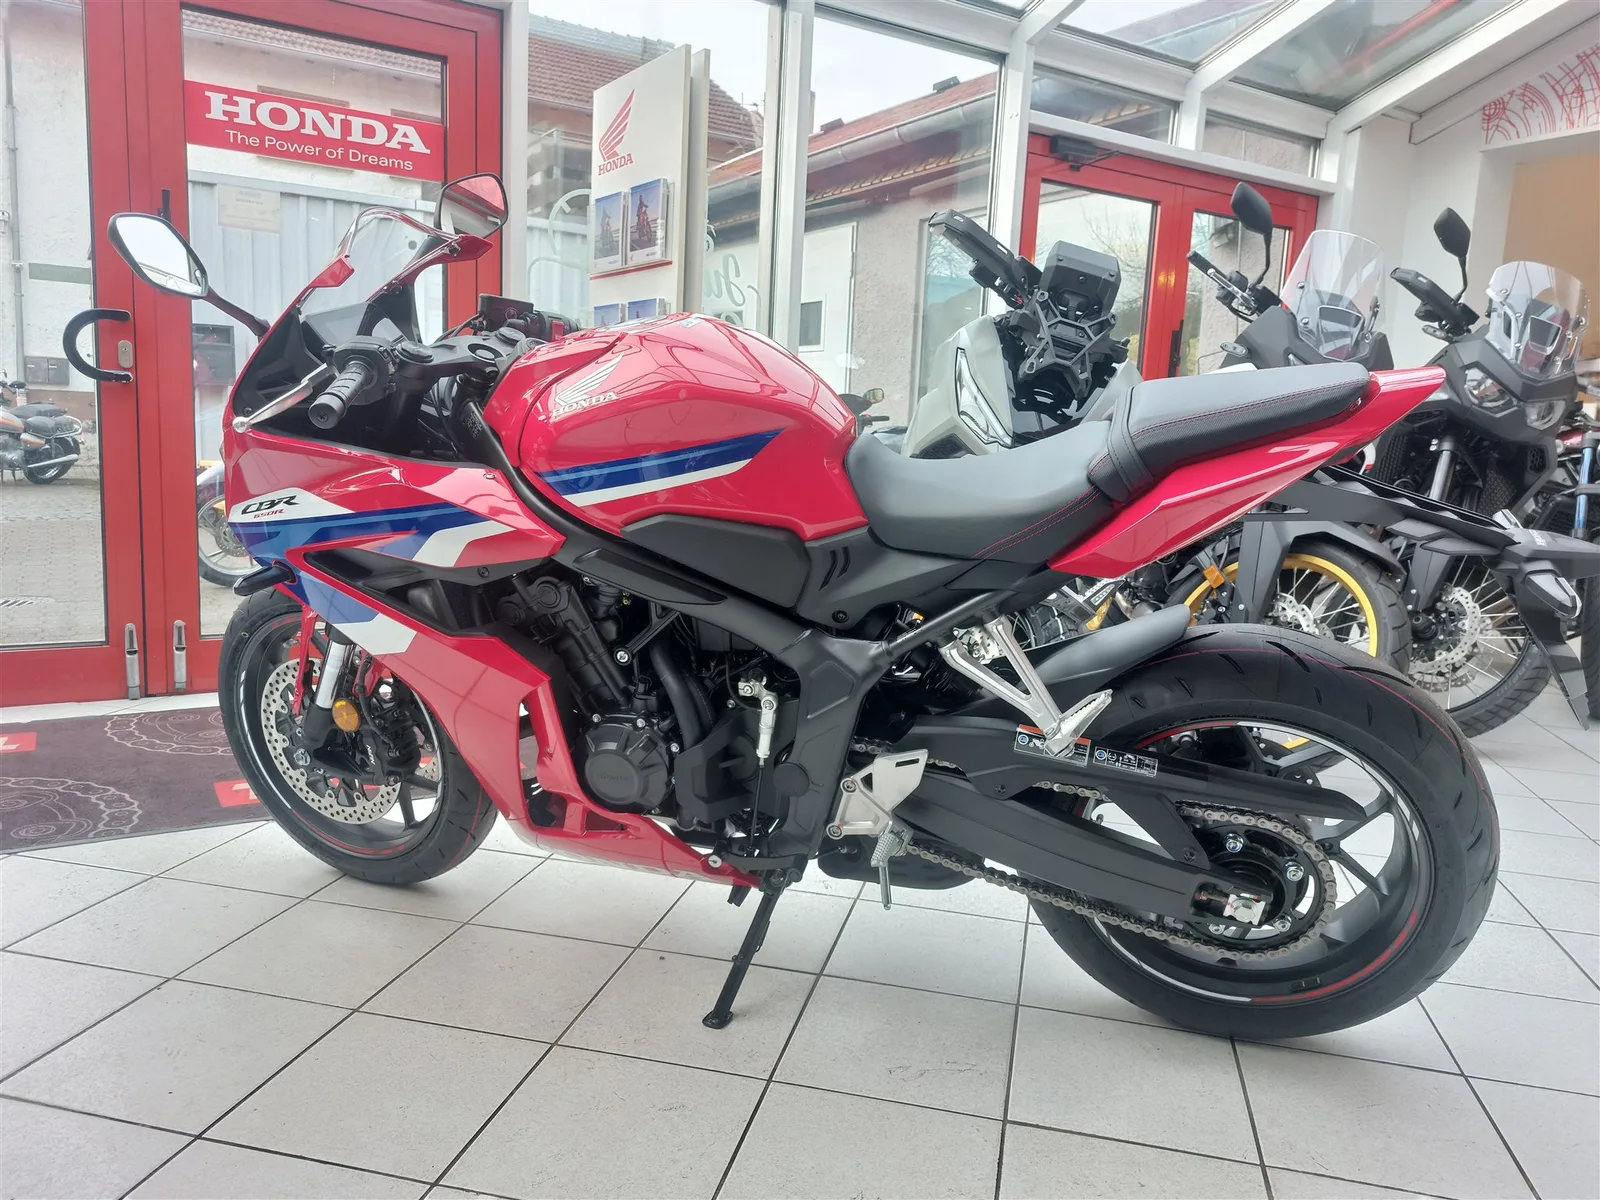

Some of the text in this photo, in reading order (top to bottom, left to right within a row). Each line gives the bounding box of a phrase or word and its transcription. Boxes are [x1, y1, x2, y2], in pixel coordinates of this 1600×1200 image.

[204, 90, 430, 154] HONDA
[225, 130, 413, 171] The Power of Dreams
[598, 153, 634, 176] HONDA
[549, 391, 619, 420] HONDA
[241, 495, 300, 515] CBR
